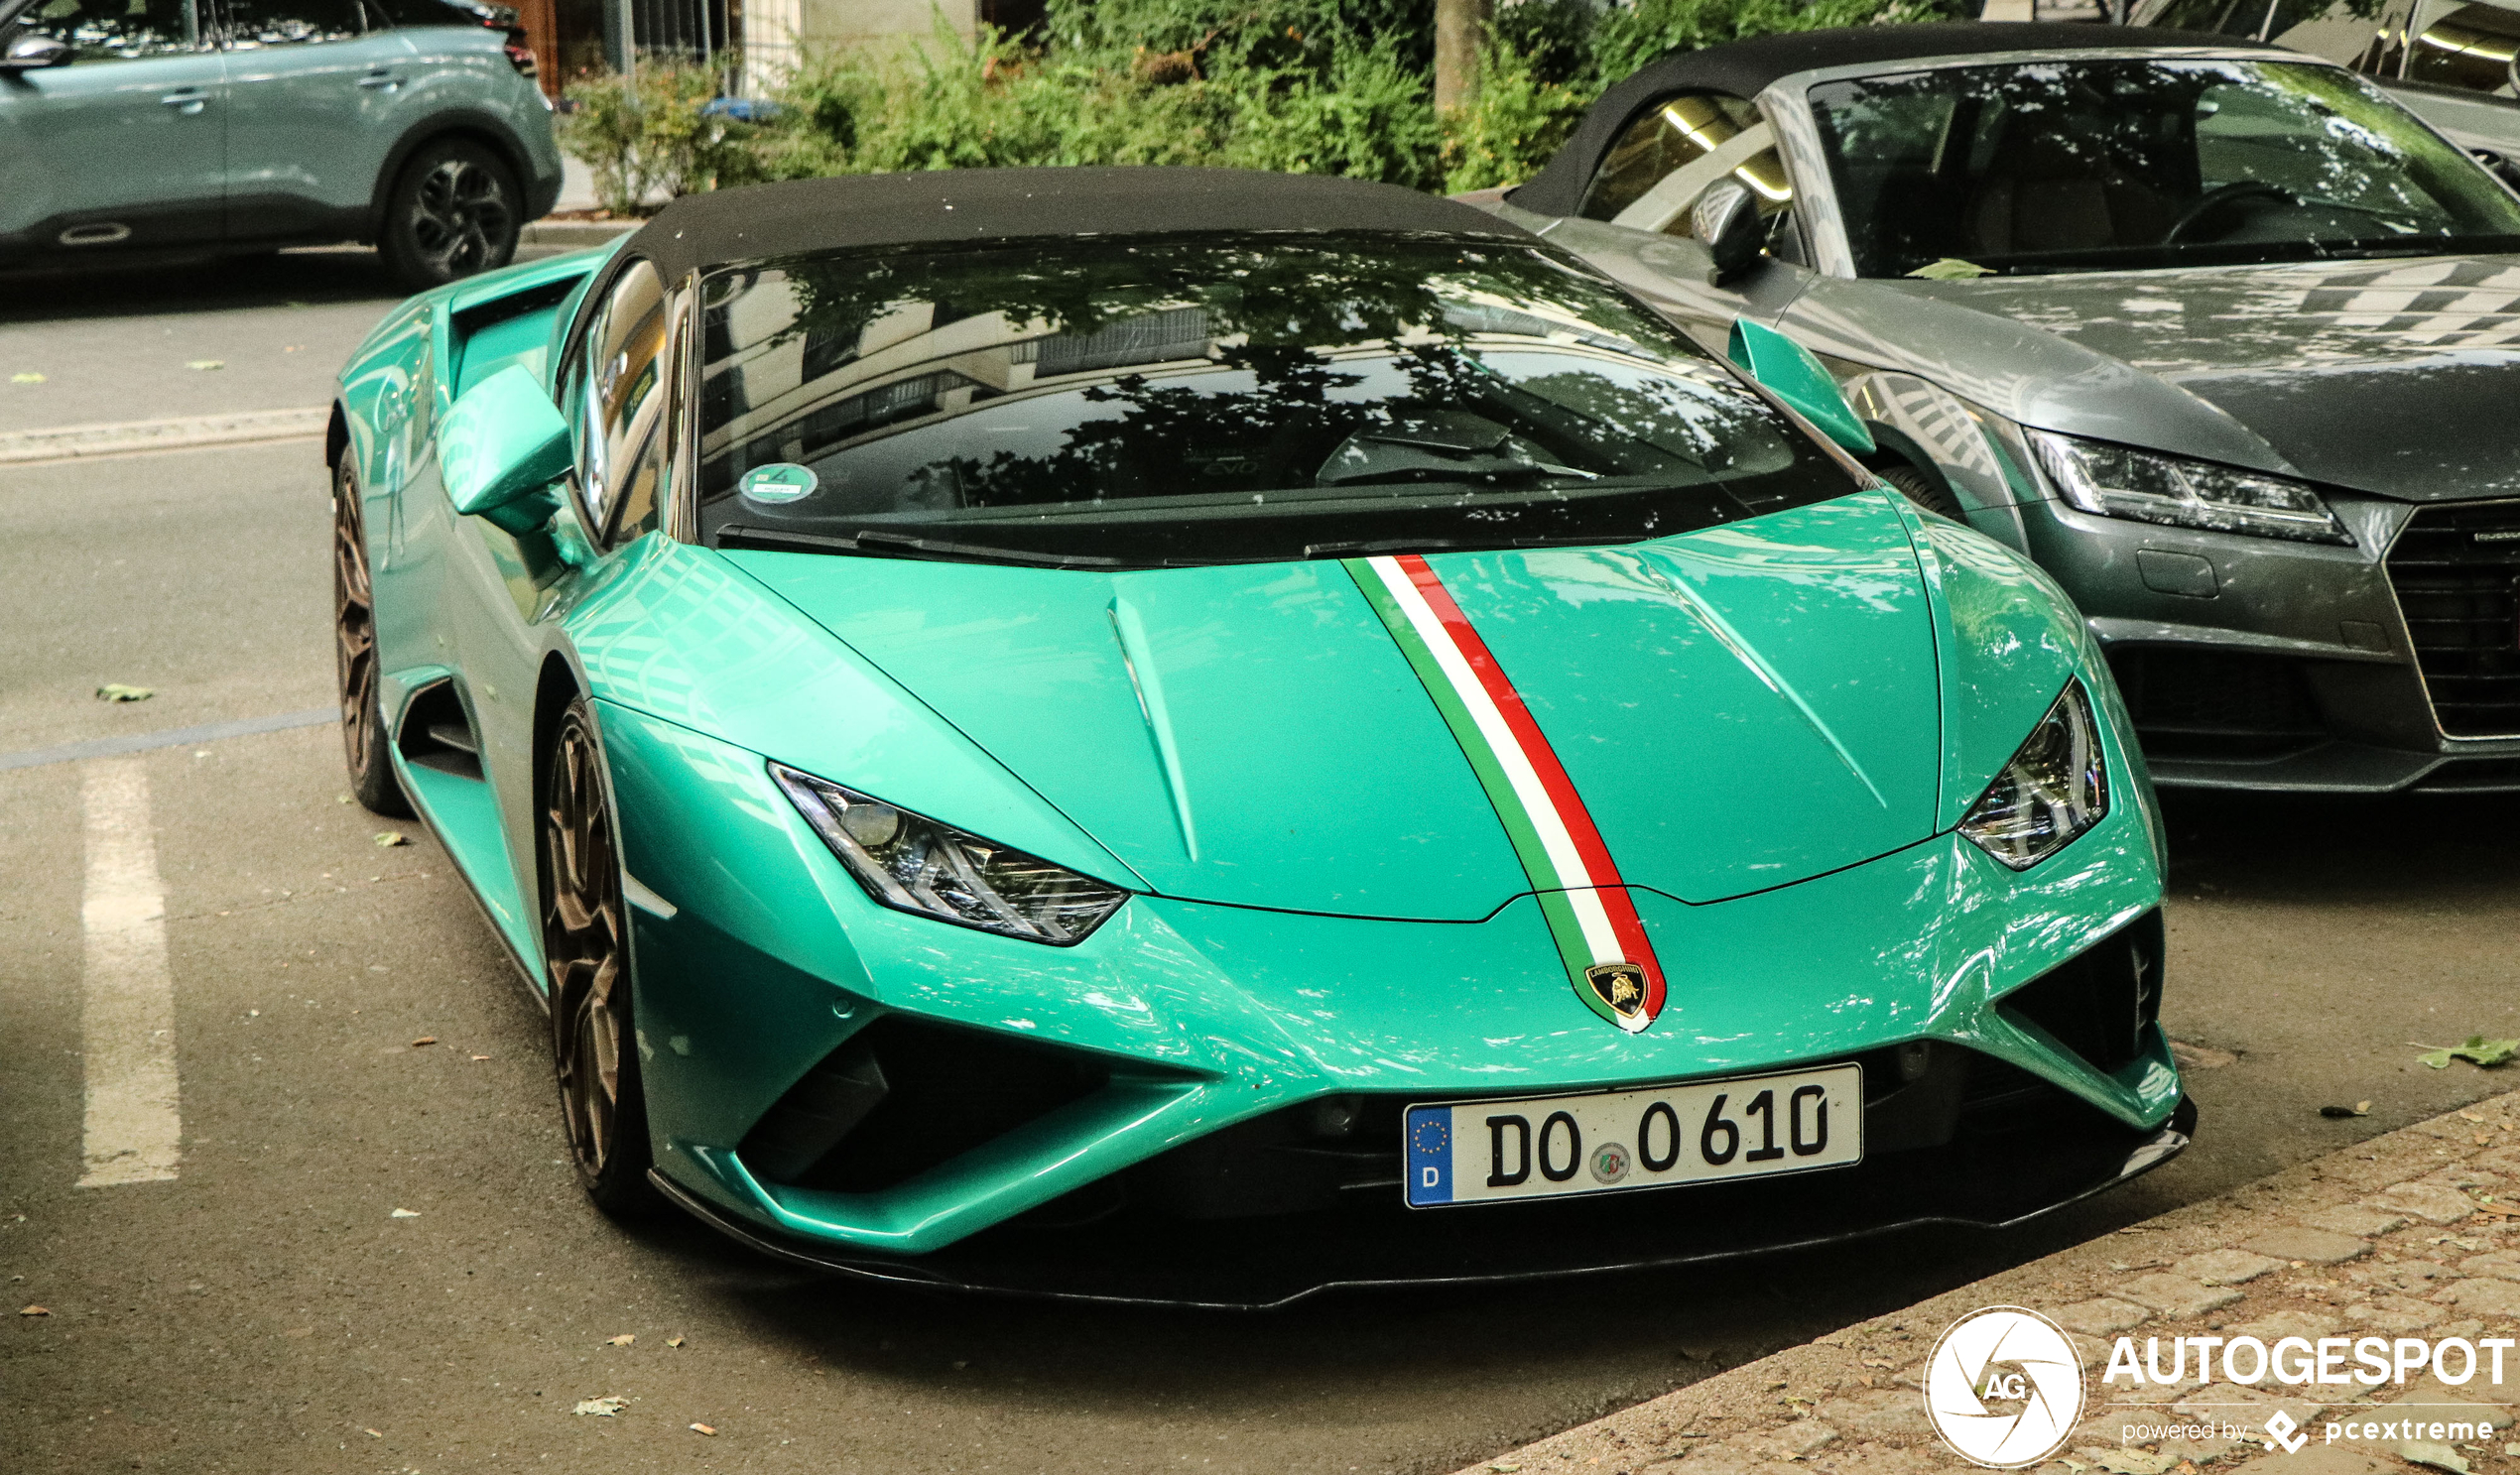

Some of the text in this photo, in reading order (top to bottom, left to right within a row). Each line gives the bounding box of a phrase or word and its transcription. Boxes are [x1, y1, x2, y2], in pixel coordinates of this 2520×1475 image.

[771, 468, 788, 483] 4
[1590, 966, 1639, 977] LAMBORGHINI
[1486, 1084, 1827, 1187] DO O 610
[1423, 1167, 1439, 1188] D
